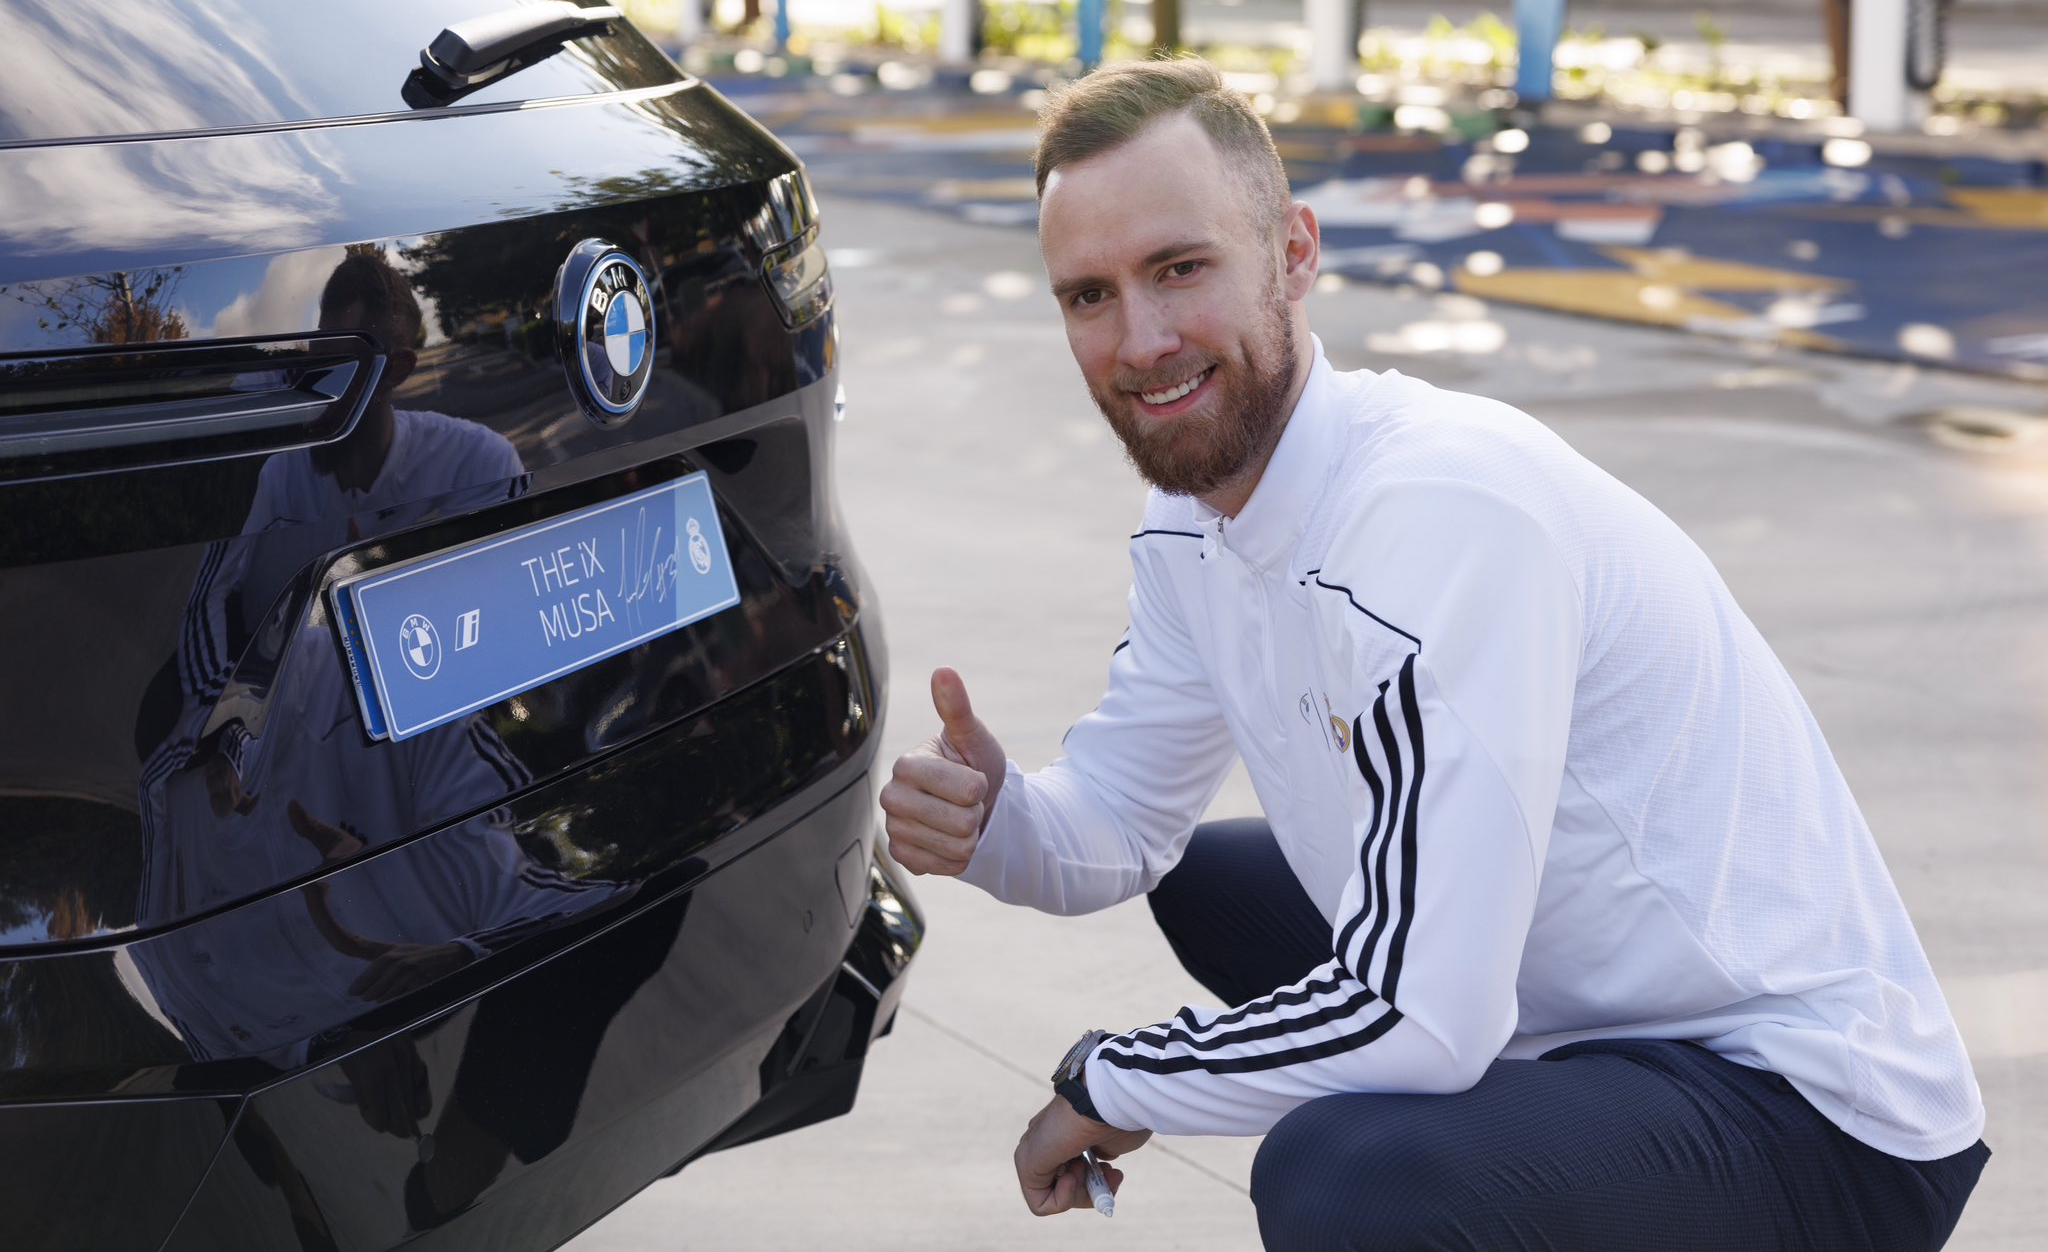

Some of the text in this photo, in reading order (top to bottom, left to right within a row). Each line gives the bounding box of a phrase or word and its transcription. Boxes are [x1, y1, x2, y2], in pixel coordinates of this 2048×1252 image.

[591, 265, 646, 315] BMW
[520, 537, 605, 597] THE iX
[402, 617, 431, 640] BMW
[539, 588, 616, 647] MUSA
